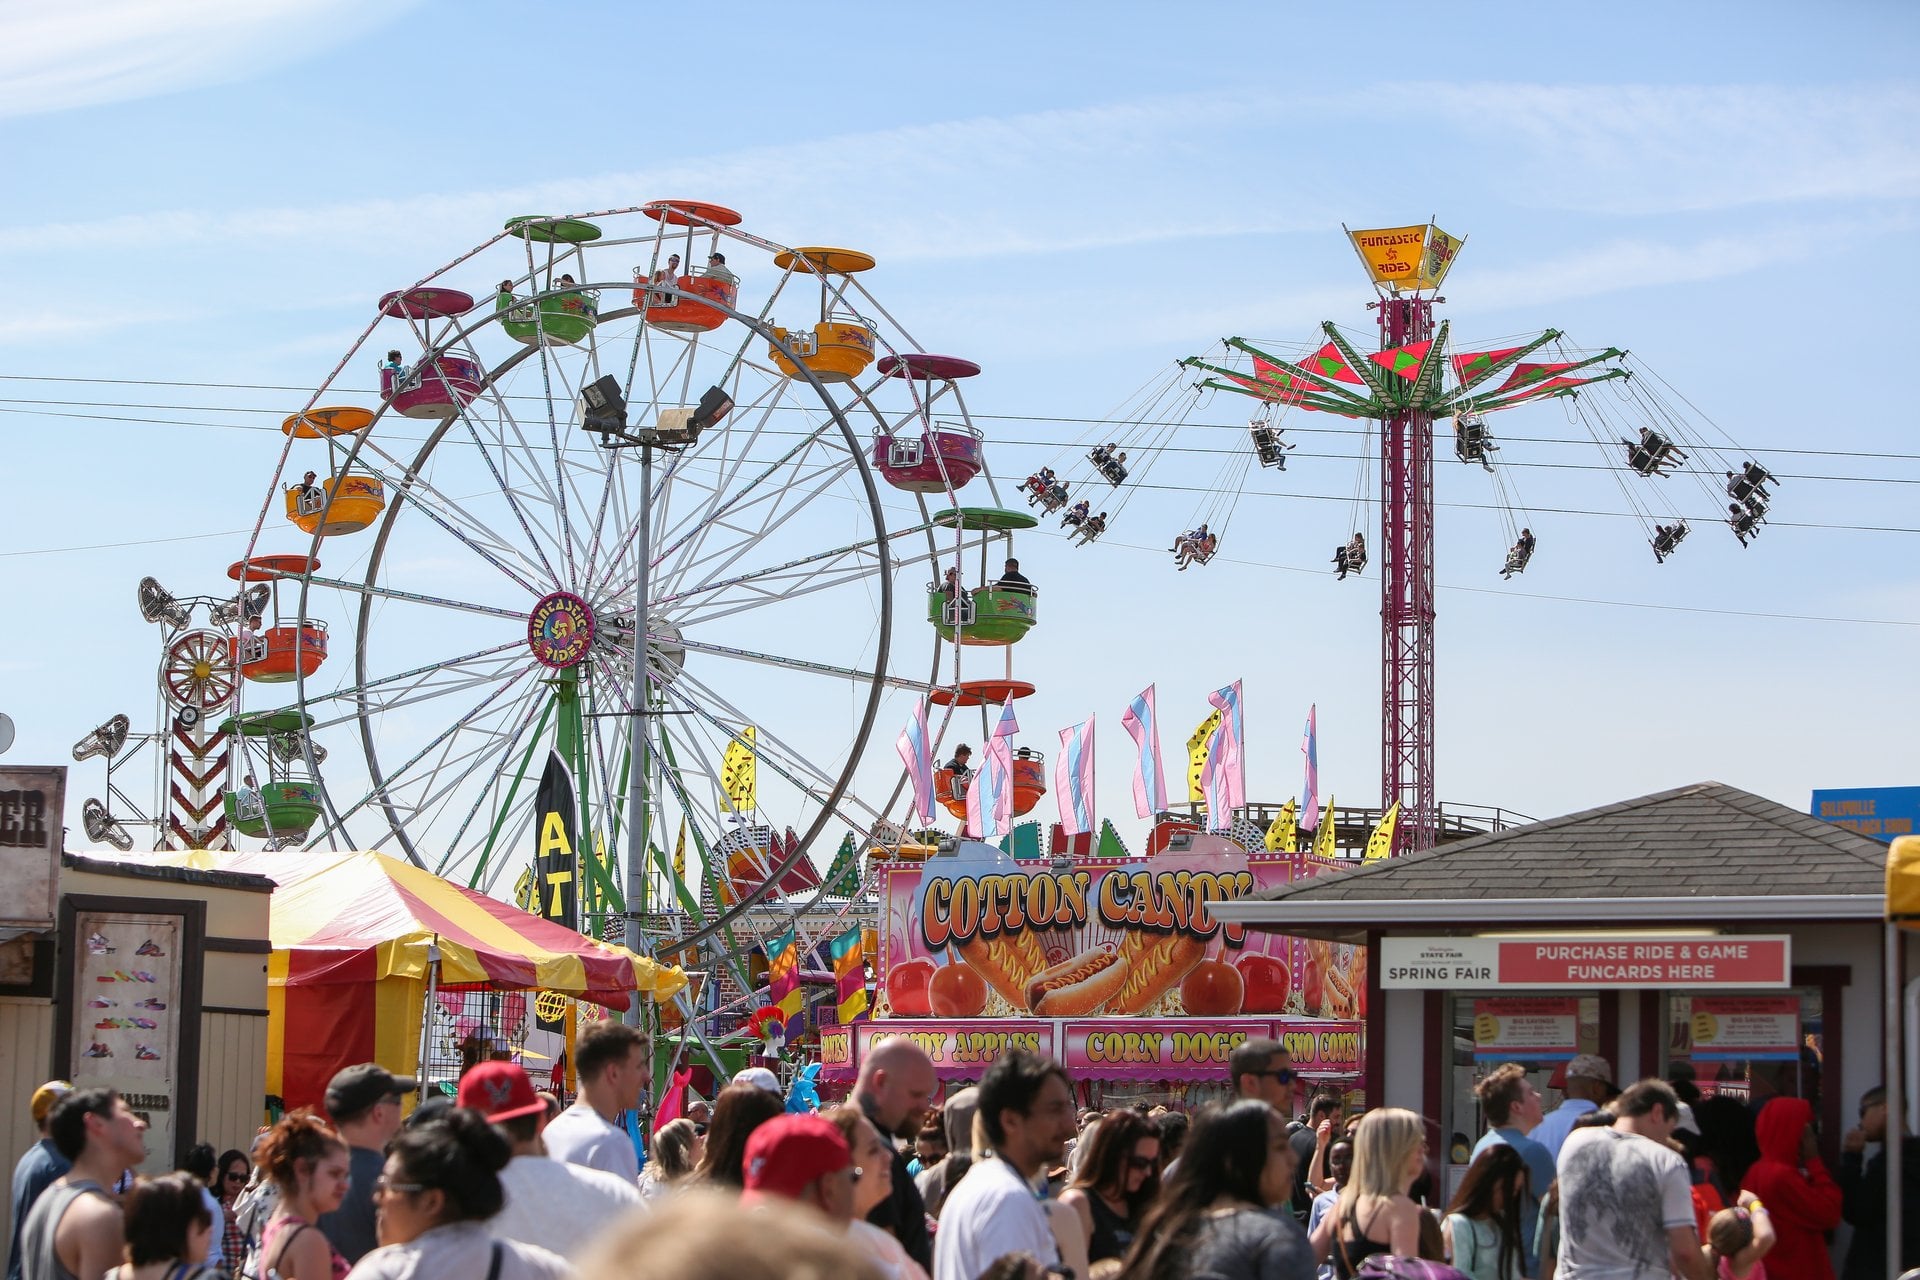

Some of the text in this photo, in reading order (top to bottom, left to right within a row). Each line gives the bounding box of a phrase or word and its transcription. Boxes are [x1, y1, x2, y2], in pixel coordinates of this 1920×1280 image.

[1378, 262, 1411, 274] RIDES
[922, 871, 1254, 951] COTTON CANDY
[1535, 945, 1748, 960] PURCHASE RIDE & GAME
[1389, 967, 1491, 980] SPRING FAIR
[1567, 965, 1715, 979] FUNCARDS HERE
[869, 1032, 1040, 1062] CDY APPLES
[1086, 1032, 1163, 1063] CORN
[1283, 1032, 1316, 1063] SNO
